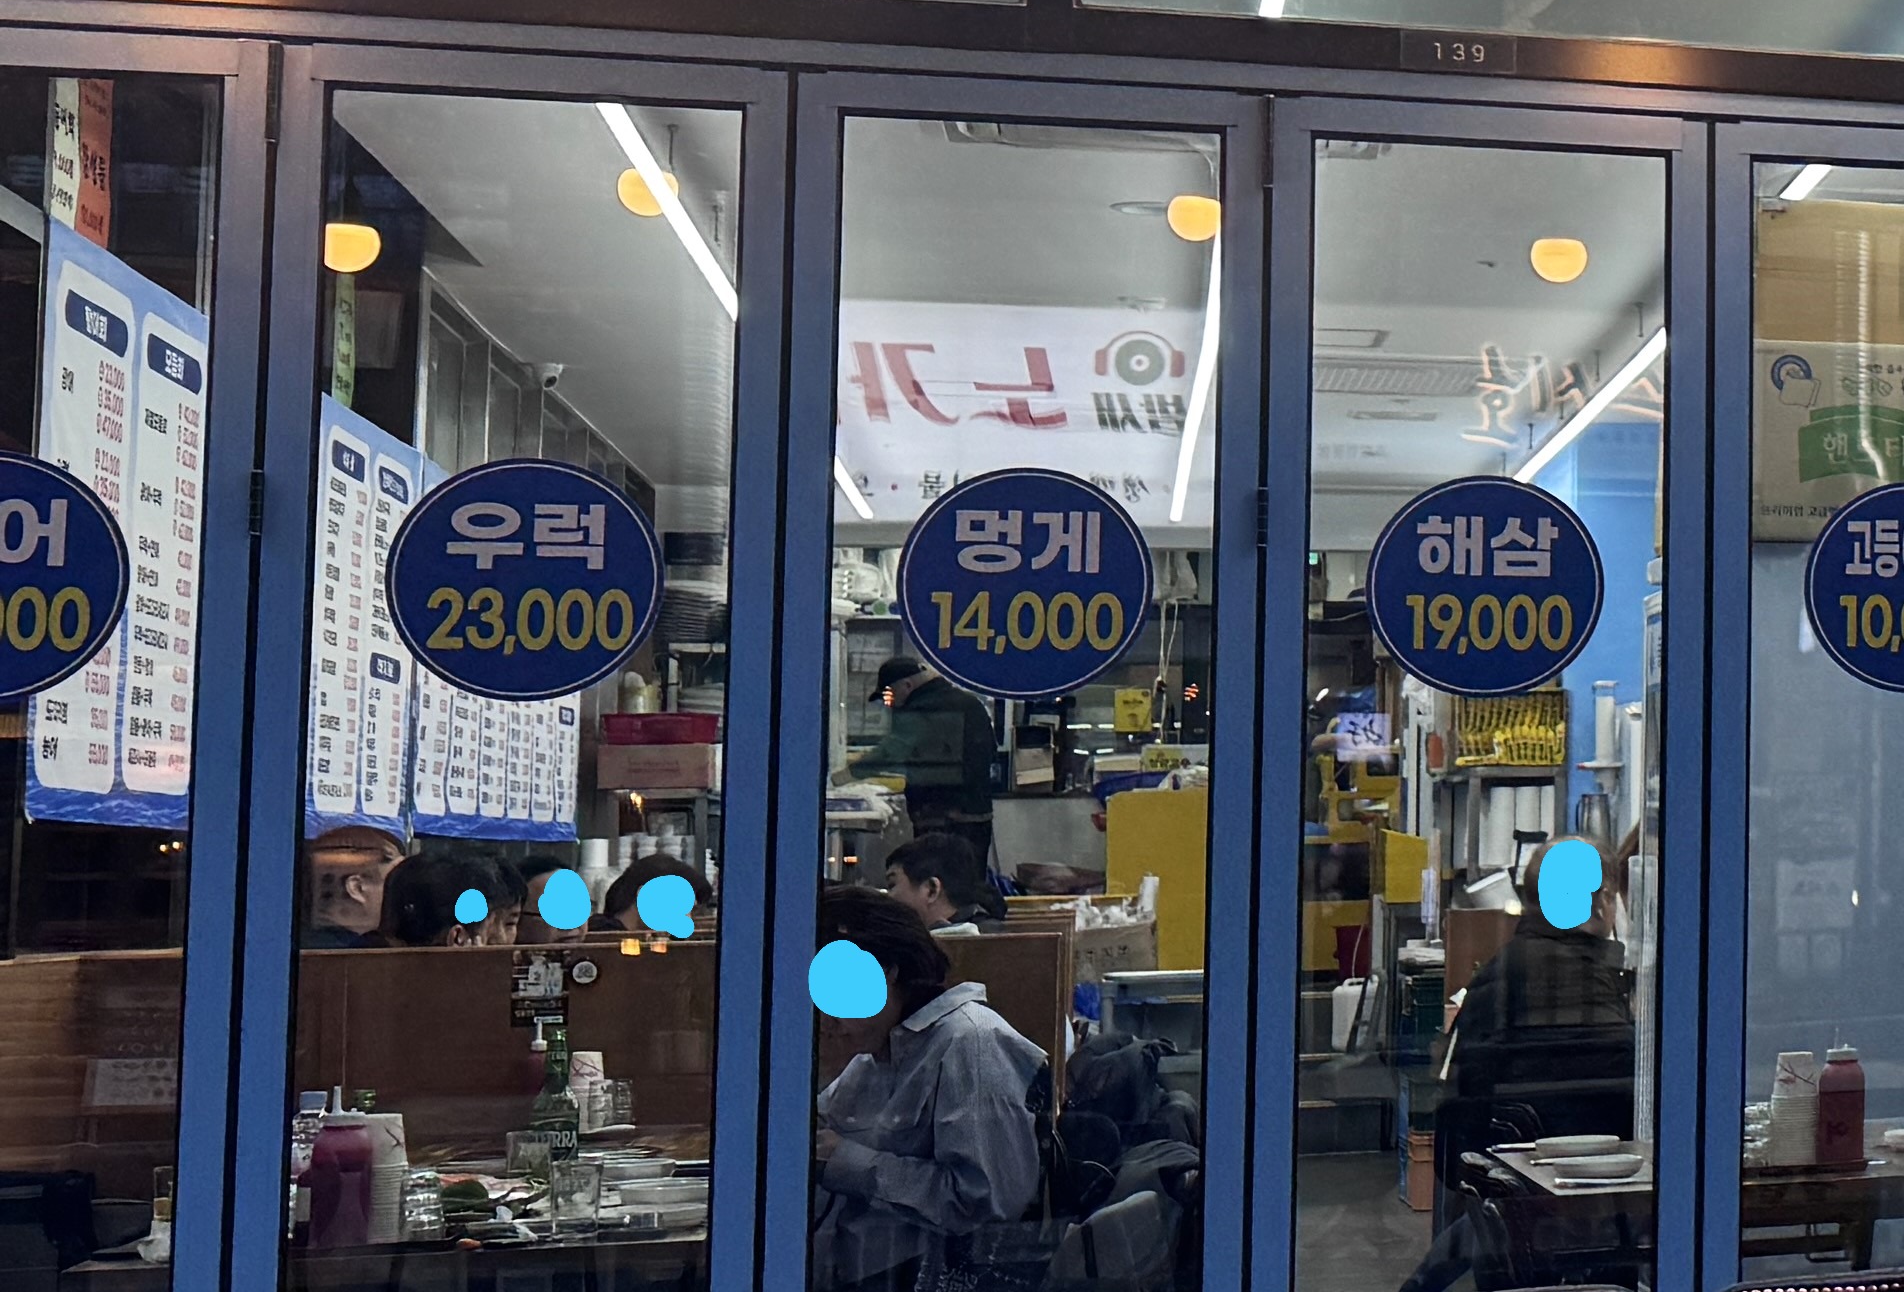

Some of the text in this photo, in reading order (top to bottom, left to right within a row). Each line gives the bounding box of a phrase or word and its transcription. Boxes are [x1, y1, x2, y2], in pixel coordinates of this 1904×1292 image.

[1433, 42, 1486, 64] 139
[0, 499, 68, 566] 어
[446, 502, 606, 571] 우럭
[955, 509, 1102, 575] 멍게
[1416, 516, 1559, 578] 해삼
[427, 588, 634, 655] 23,000
[931, 592, 1125, 656] 14,000
[1405, 595, 1574, 656] 19,000
